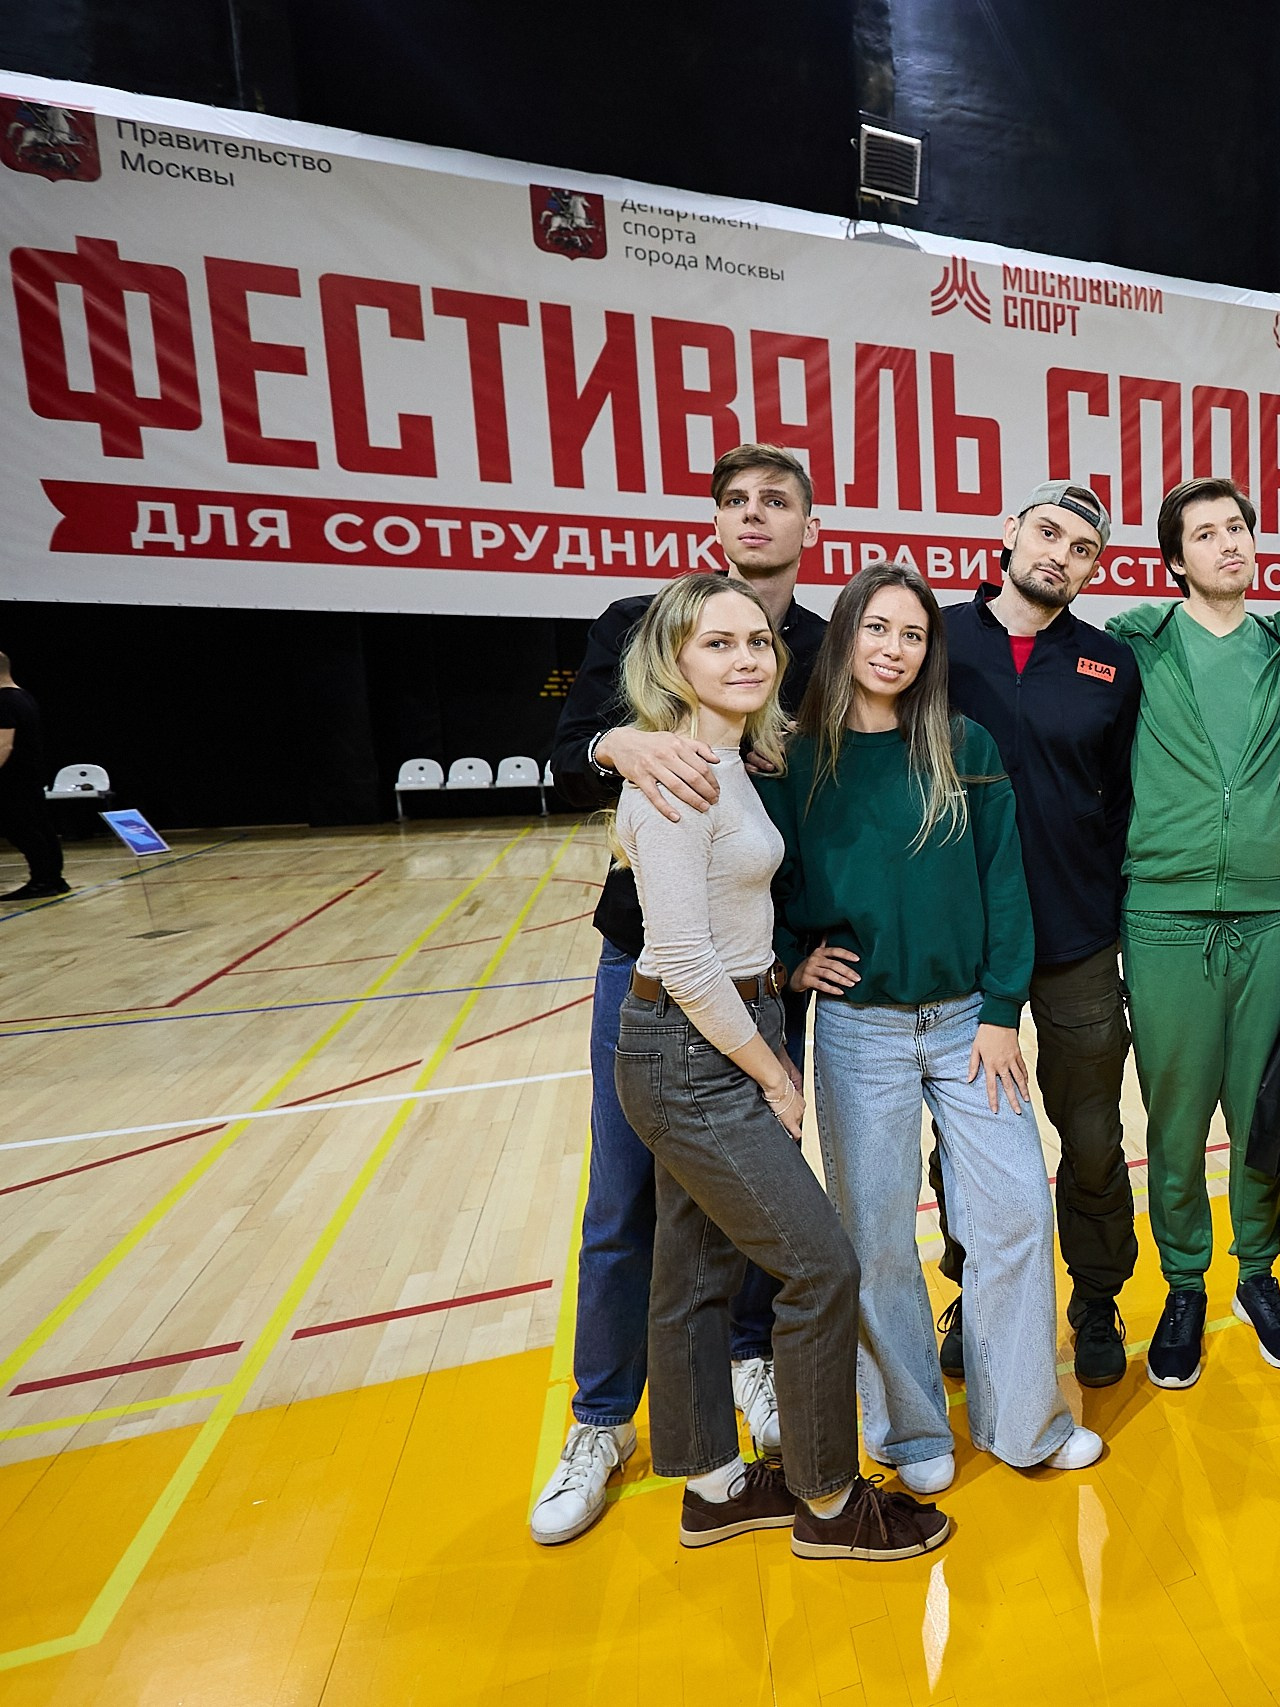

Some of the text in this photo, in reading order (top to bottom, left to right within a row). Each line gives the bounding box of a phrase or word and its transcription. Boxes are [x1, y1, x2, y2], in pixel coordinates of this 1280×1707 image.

[116, 118, 332, 174] Правительство
[120, 150, 235, 187] Москвы
[623, 220, 697, 245] спорта
[625, 245, 785, 281] города Москвы
[1003, 295, 1081, 337] СПОРТ
[9, 235, 1003, 517] ФЕСТИВАЛЬ
[131, 501, 293, 552] ДЛЯ
[324, 512, 723, 572] СОТРУДНИК
